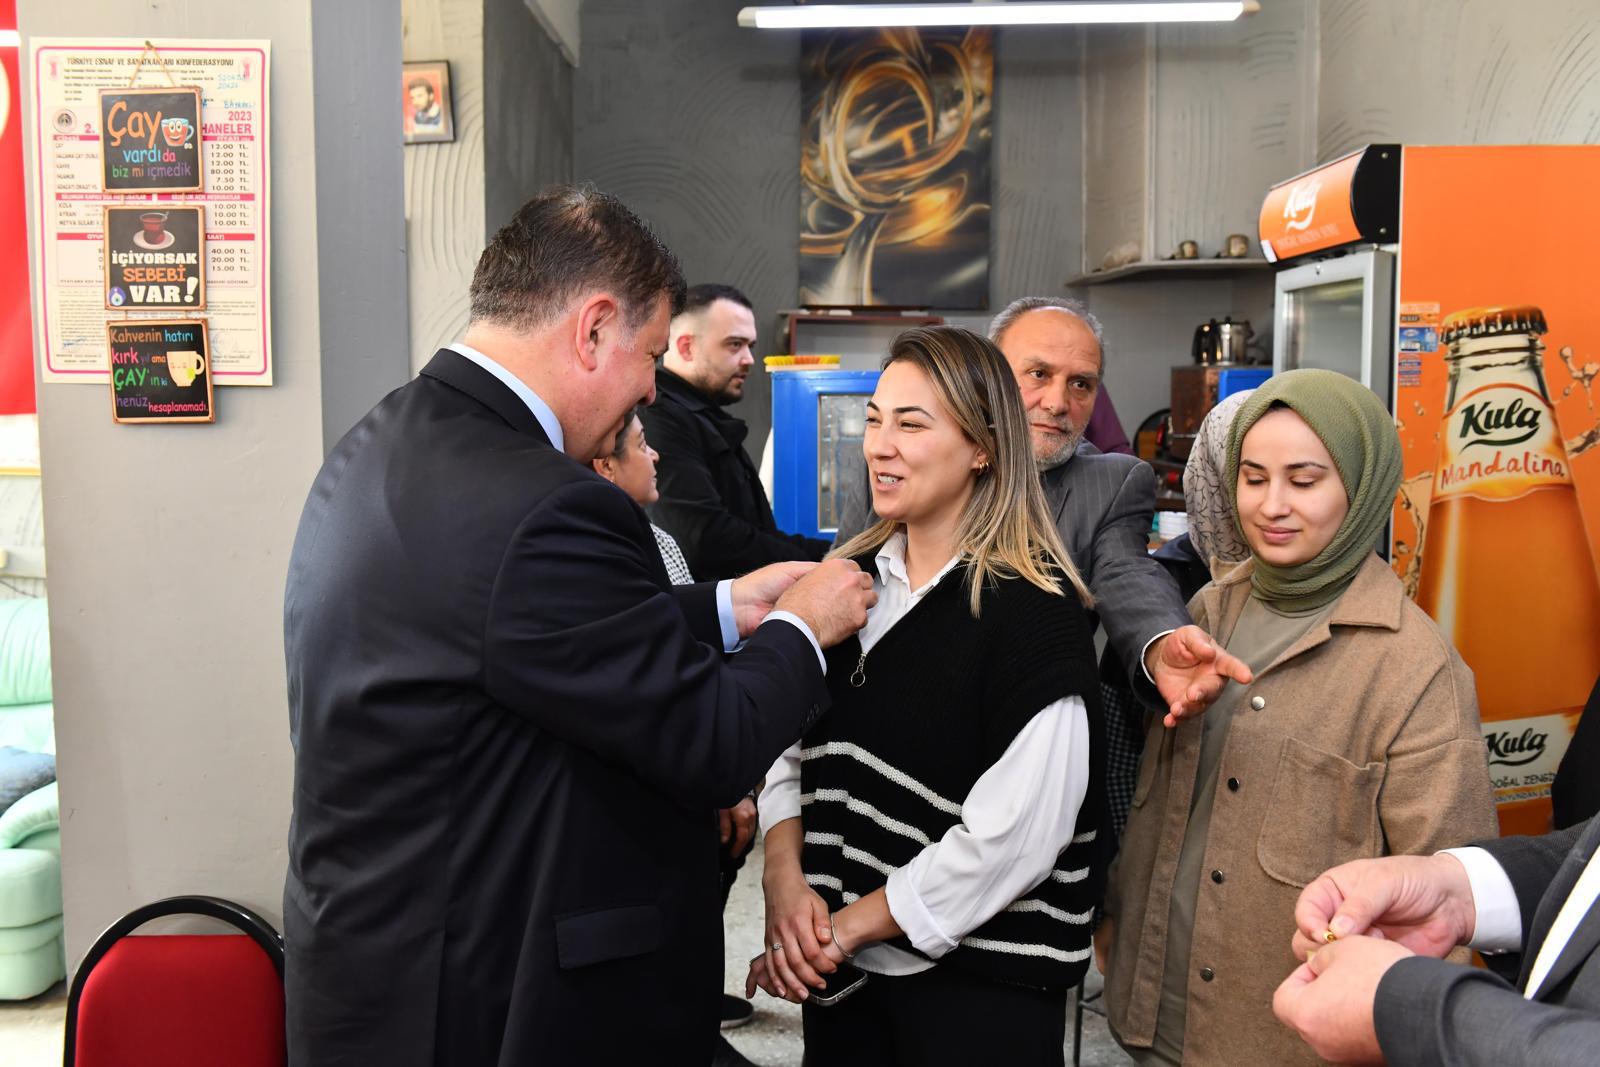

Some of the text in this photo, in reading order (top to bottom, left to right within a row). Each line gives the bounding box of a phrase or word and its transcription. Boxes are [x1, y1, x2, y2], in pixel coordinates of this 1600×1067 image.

[117, 58, 126, 66] VE
[108, 100, 162, 149] Çay
[228, 111, 252, 121] 2023
[123, 144, 176, 163] vardı da
[112, 164, 128, 178] biz
[132, 165, 144, 178] mi
[112, 250, 198, 267] İÇİYORSAK
[123, 264, 186, 282] SEBEBİ
[110, 328, 194, 344] Kahvenin hatırı
[112, 347, 140, 364] kırk
[152, 355, 166, 364] ama
[116, 394, 148, 408] henüz
[1460, 398, 1542, 438] Kula
[1441, 451, 1564, 489] Mandalina
[1484, 728, 1548, 758] Kula
